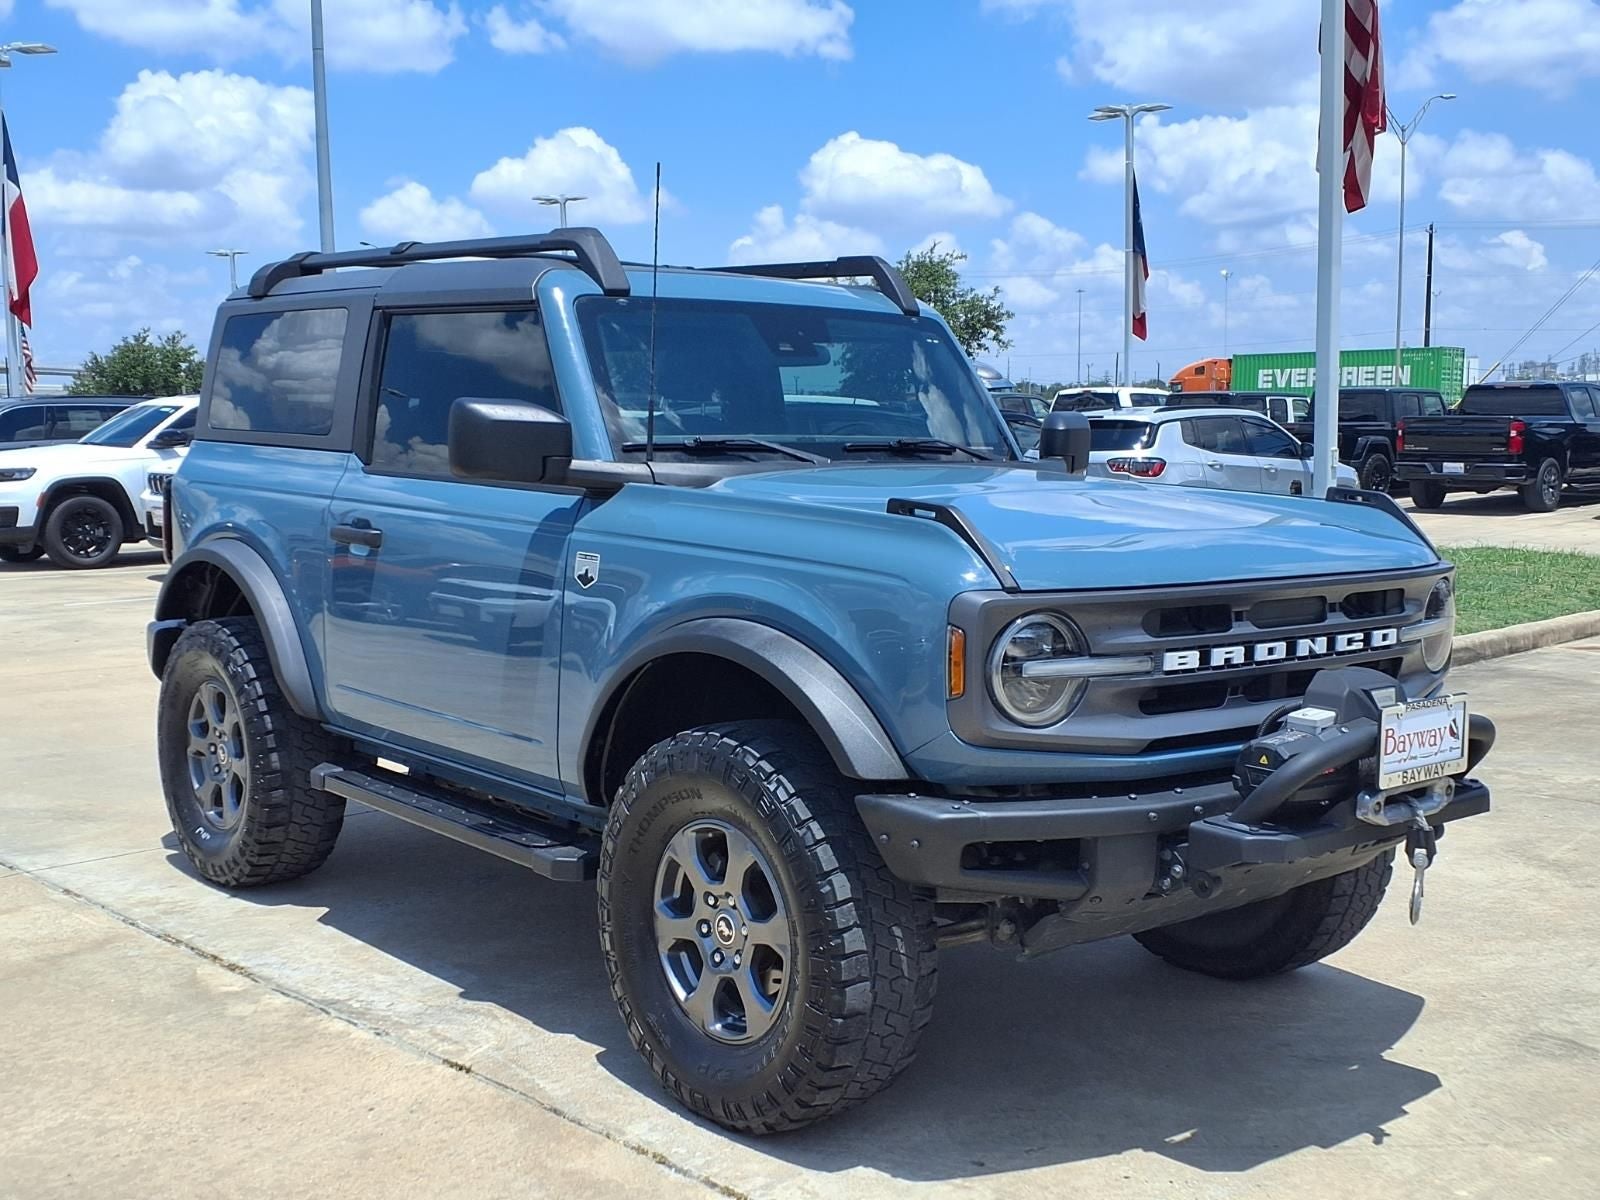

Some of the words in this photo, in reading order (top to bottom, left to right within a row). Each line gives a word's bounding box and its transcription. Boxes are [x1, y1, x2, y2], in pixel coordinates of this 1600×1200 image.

[1257, 365, 1411, 389] EVERREEN
[1162, 628, 1398, 671] BRONCO
[1405, 698, 1448, 712] PASADENA
[1384, 726, 1447, 763] Bayway
[1401, 763, 1446, 784] BAYWAY
[628, 787, 704, 855] THOMPSON
